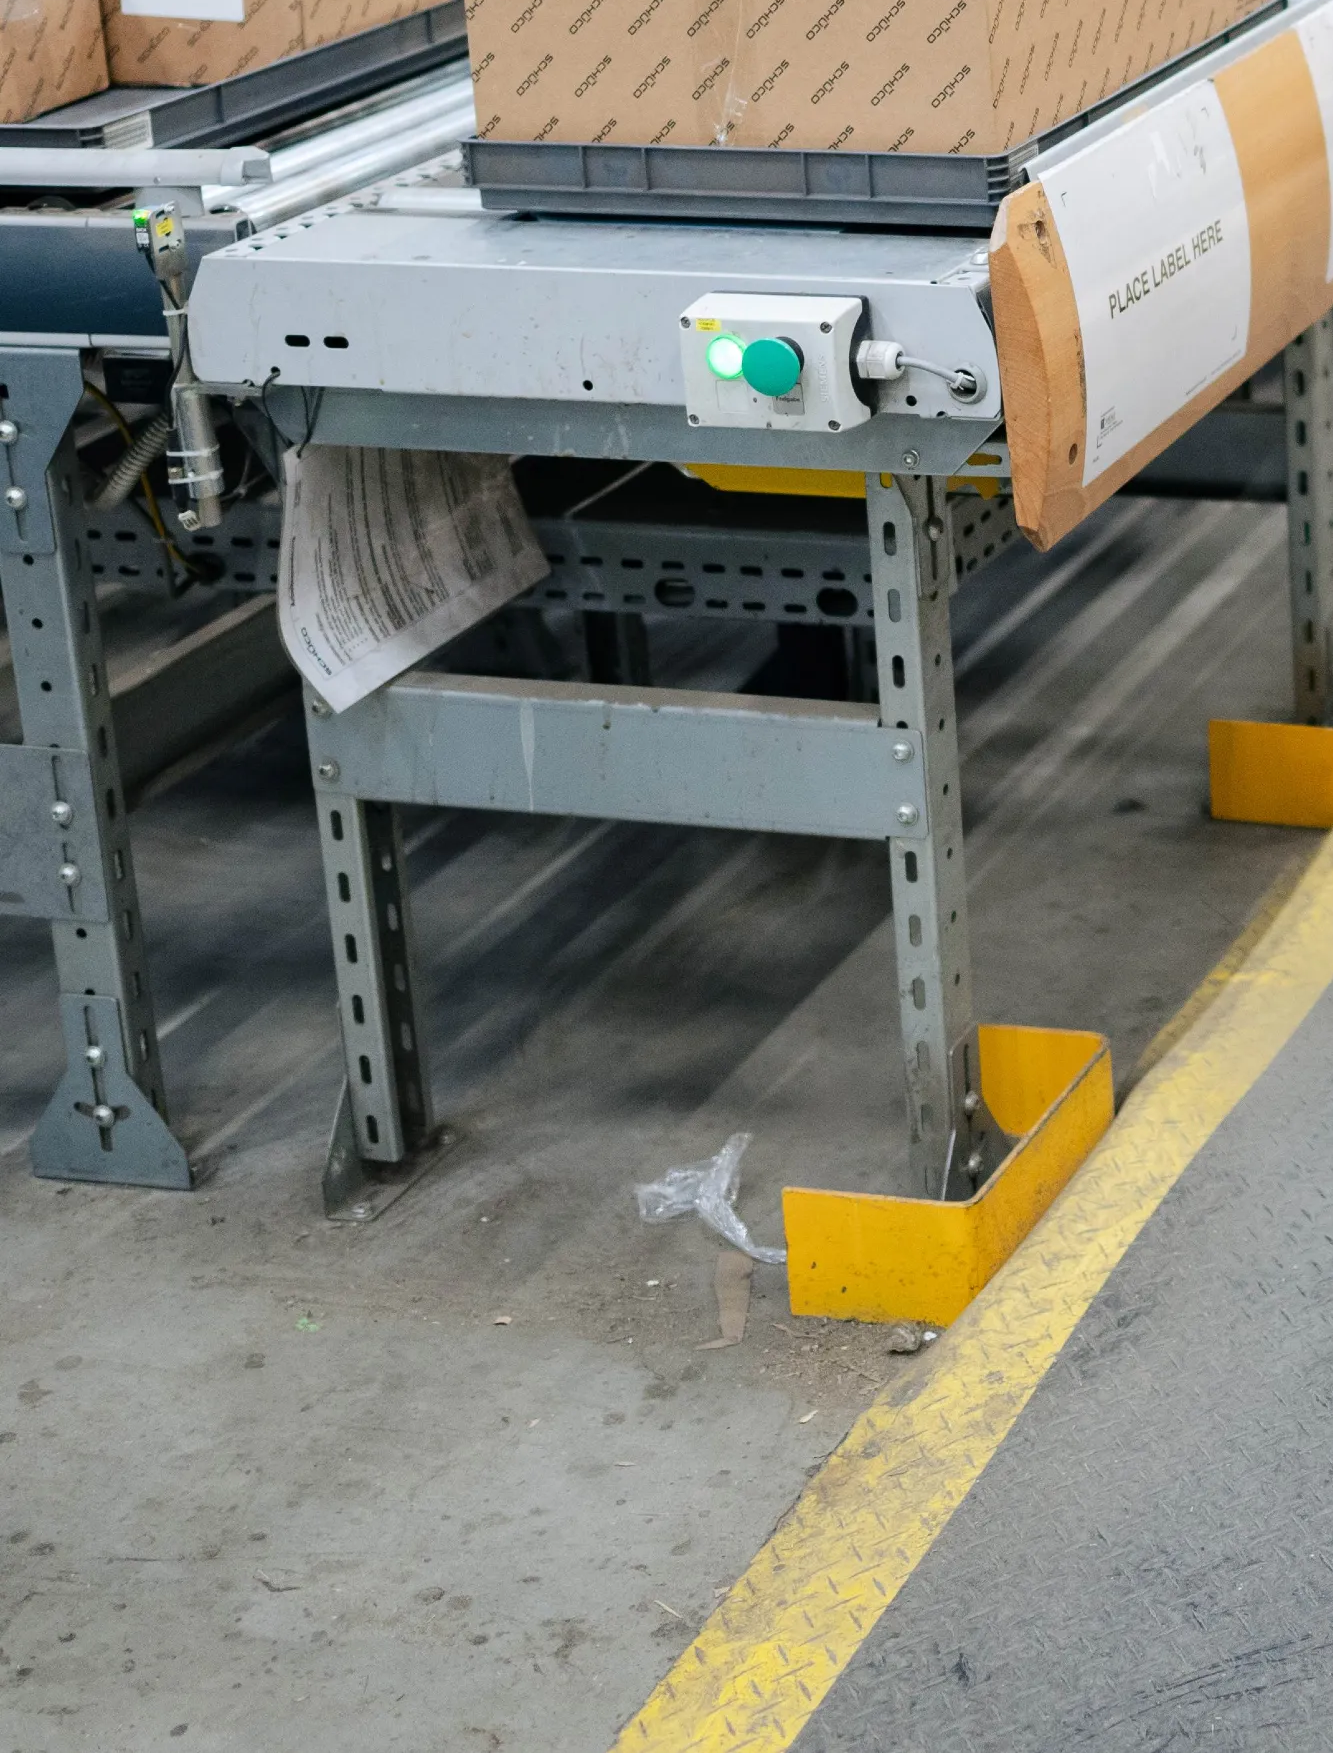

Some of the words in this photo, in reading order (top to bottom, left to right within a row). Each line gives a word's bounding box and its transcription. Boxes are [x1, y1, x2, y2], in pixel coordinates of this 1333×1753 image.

[927, 0, 967, 43] SCHÜCO
[811, 61, 849, 104] SCHÜCO
[1109, 270, 1150, 319] PLACE
[1152, 243, 1191, 288] LABEL
[1192, 219, 1223, 260] HERE
